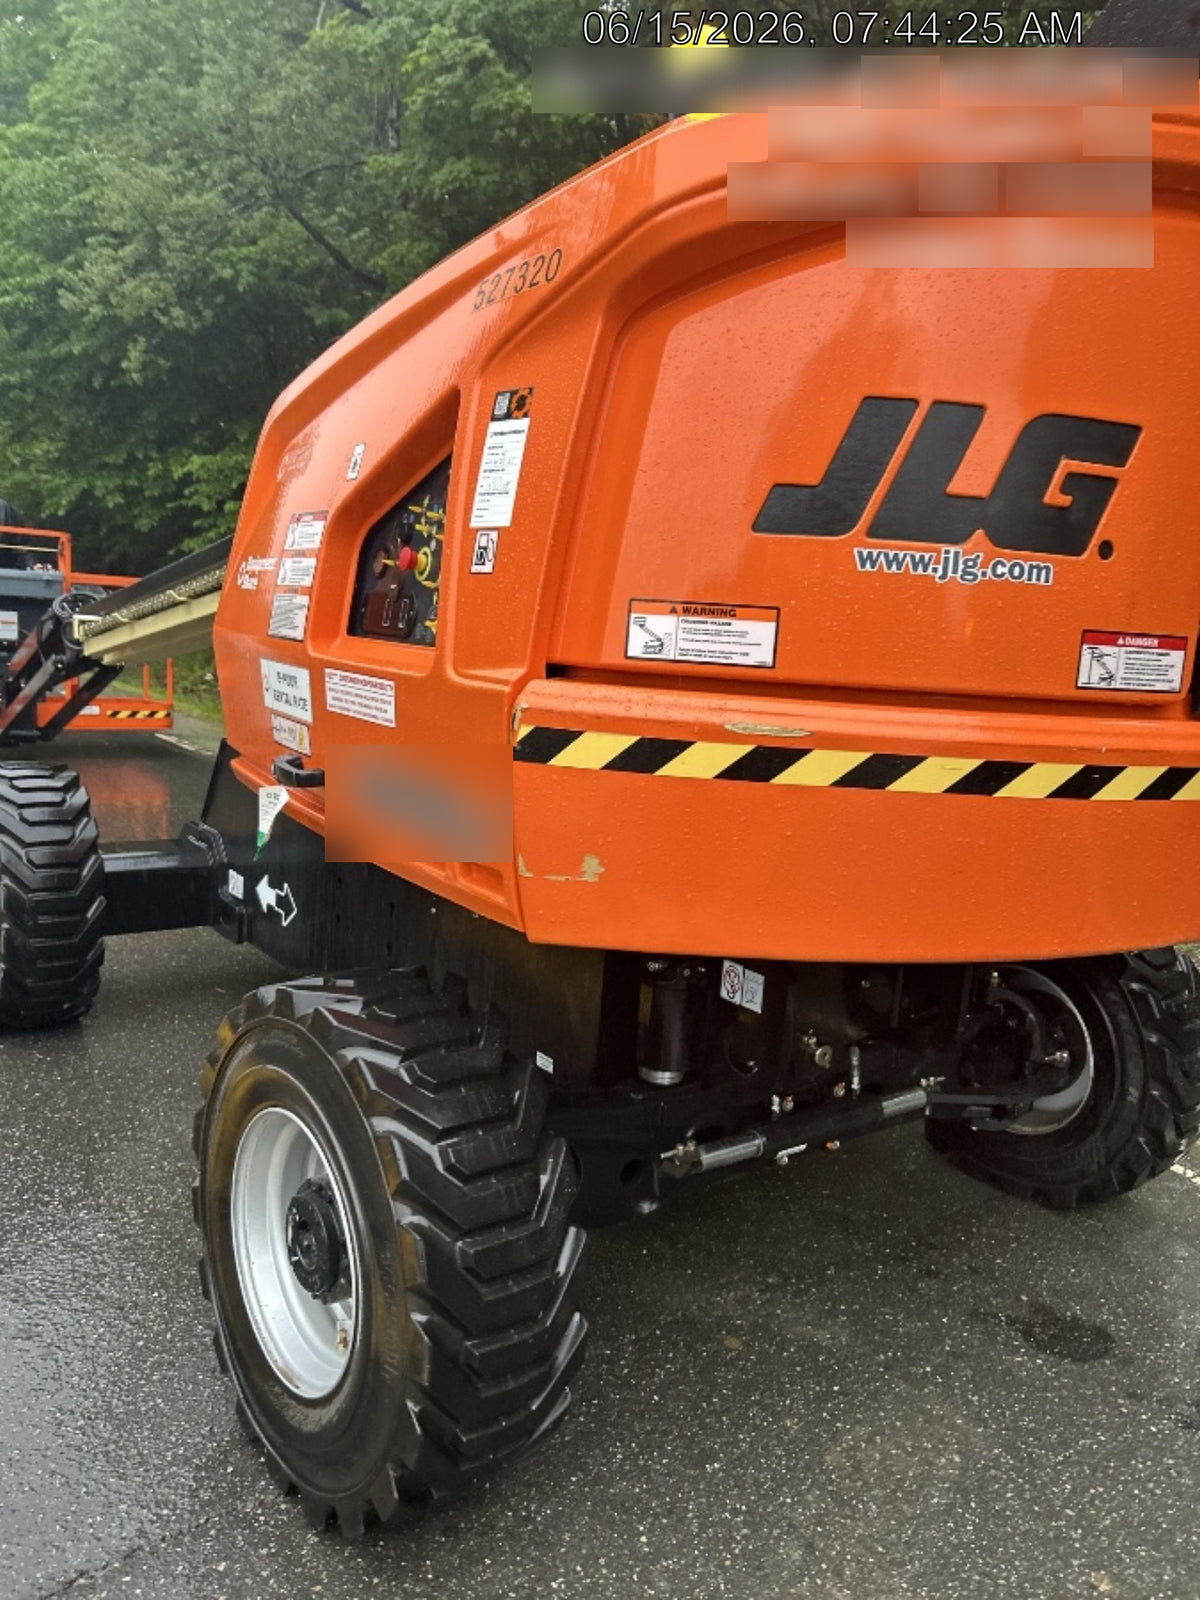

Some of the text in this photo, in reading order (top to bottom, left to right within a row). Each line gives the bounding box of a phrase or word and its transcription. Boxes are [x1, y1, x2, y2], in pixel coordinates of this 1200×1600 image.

[473, 248, 562, 310] 527320
[752, 395, 1143, 558] JLG
[855, 547, 1053, 585] www.jlg.com
[682, 606, 737, 618] WARNING
[1125, 637, 1158, 648] DANGER
